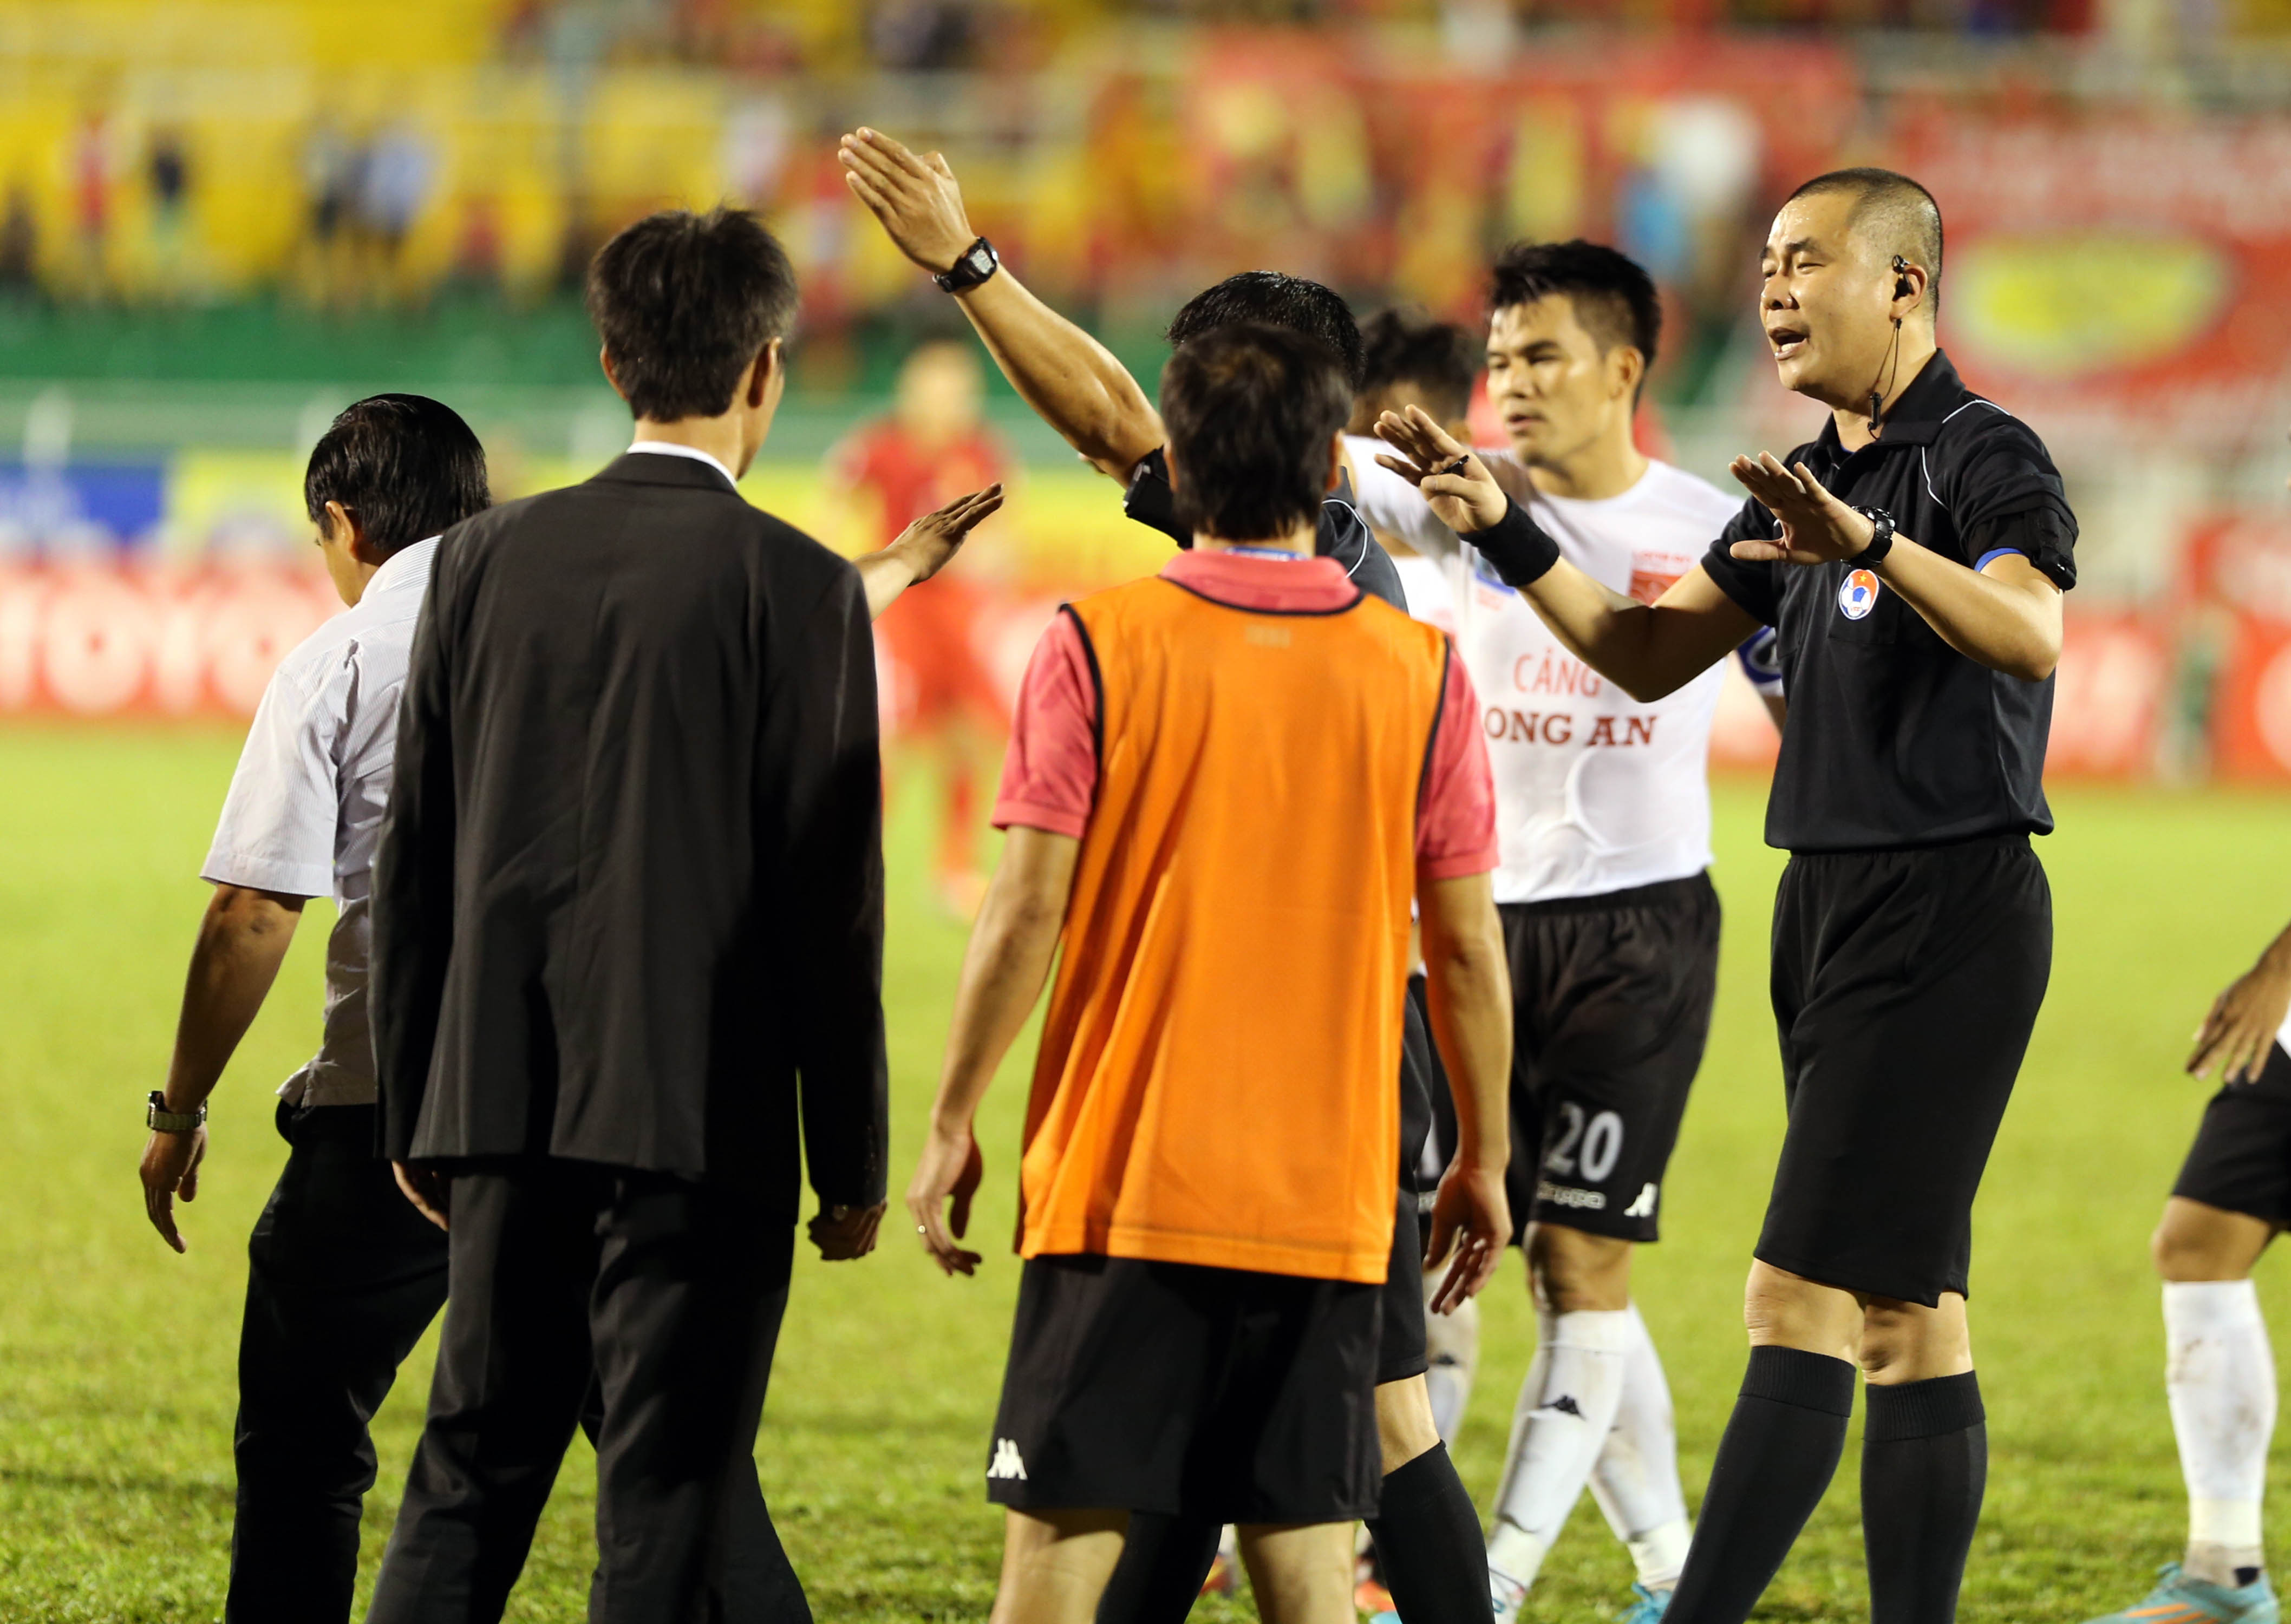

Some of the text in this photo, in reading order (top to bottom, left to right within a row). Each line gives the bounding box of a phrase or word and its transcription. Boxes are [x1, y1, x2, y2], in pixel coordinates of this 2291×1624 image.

[1484, 707, 1658, 746] ONG AN
[1545, 1101, 1623, 1183] 20
